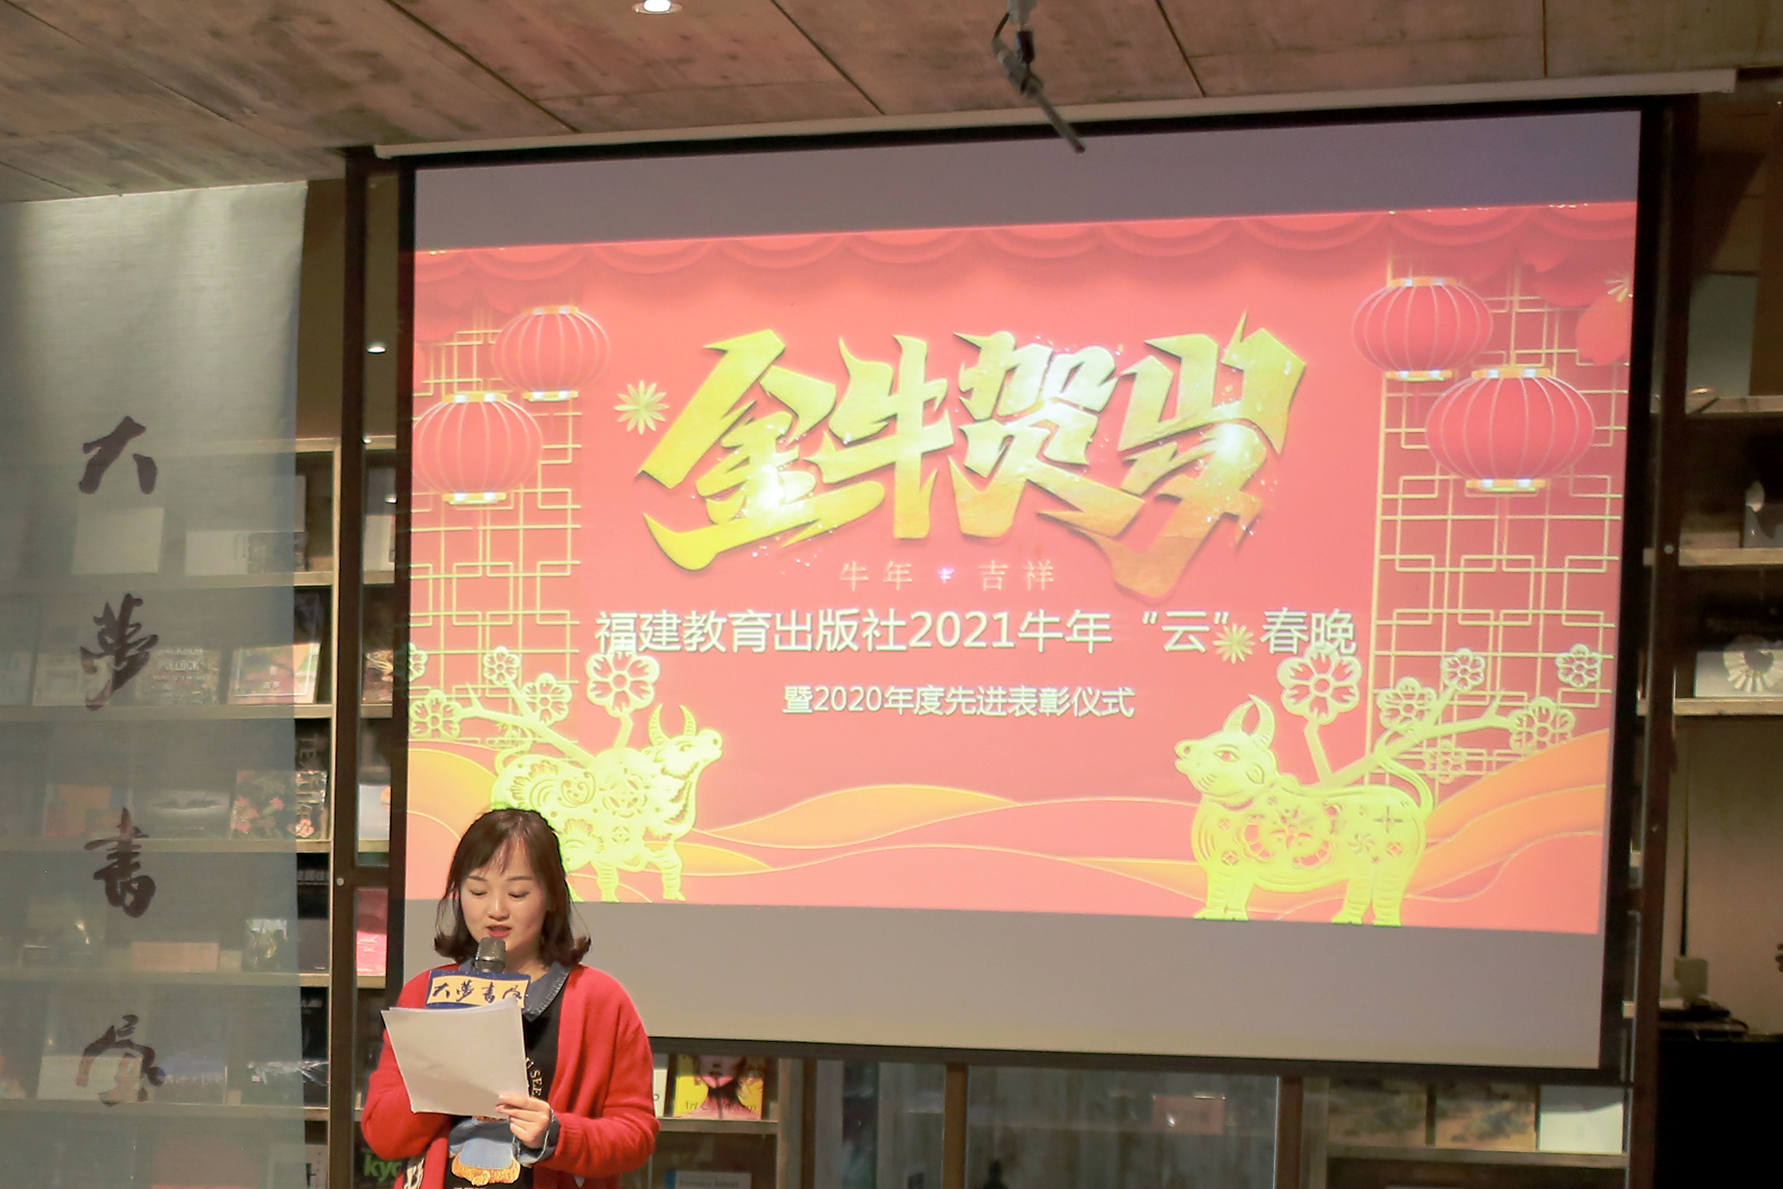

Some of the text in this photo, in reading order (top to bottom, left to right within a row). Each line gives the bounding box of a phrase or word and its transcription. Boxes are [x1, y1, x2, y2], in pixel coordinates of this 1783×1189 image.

[637, 311, 1307, 598] 金牛贺岁
[839, 559, 1055, 592] 牛年 吉祥
[781, 684, 1136, 718] 暨2020年度先进表彰仪式
